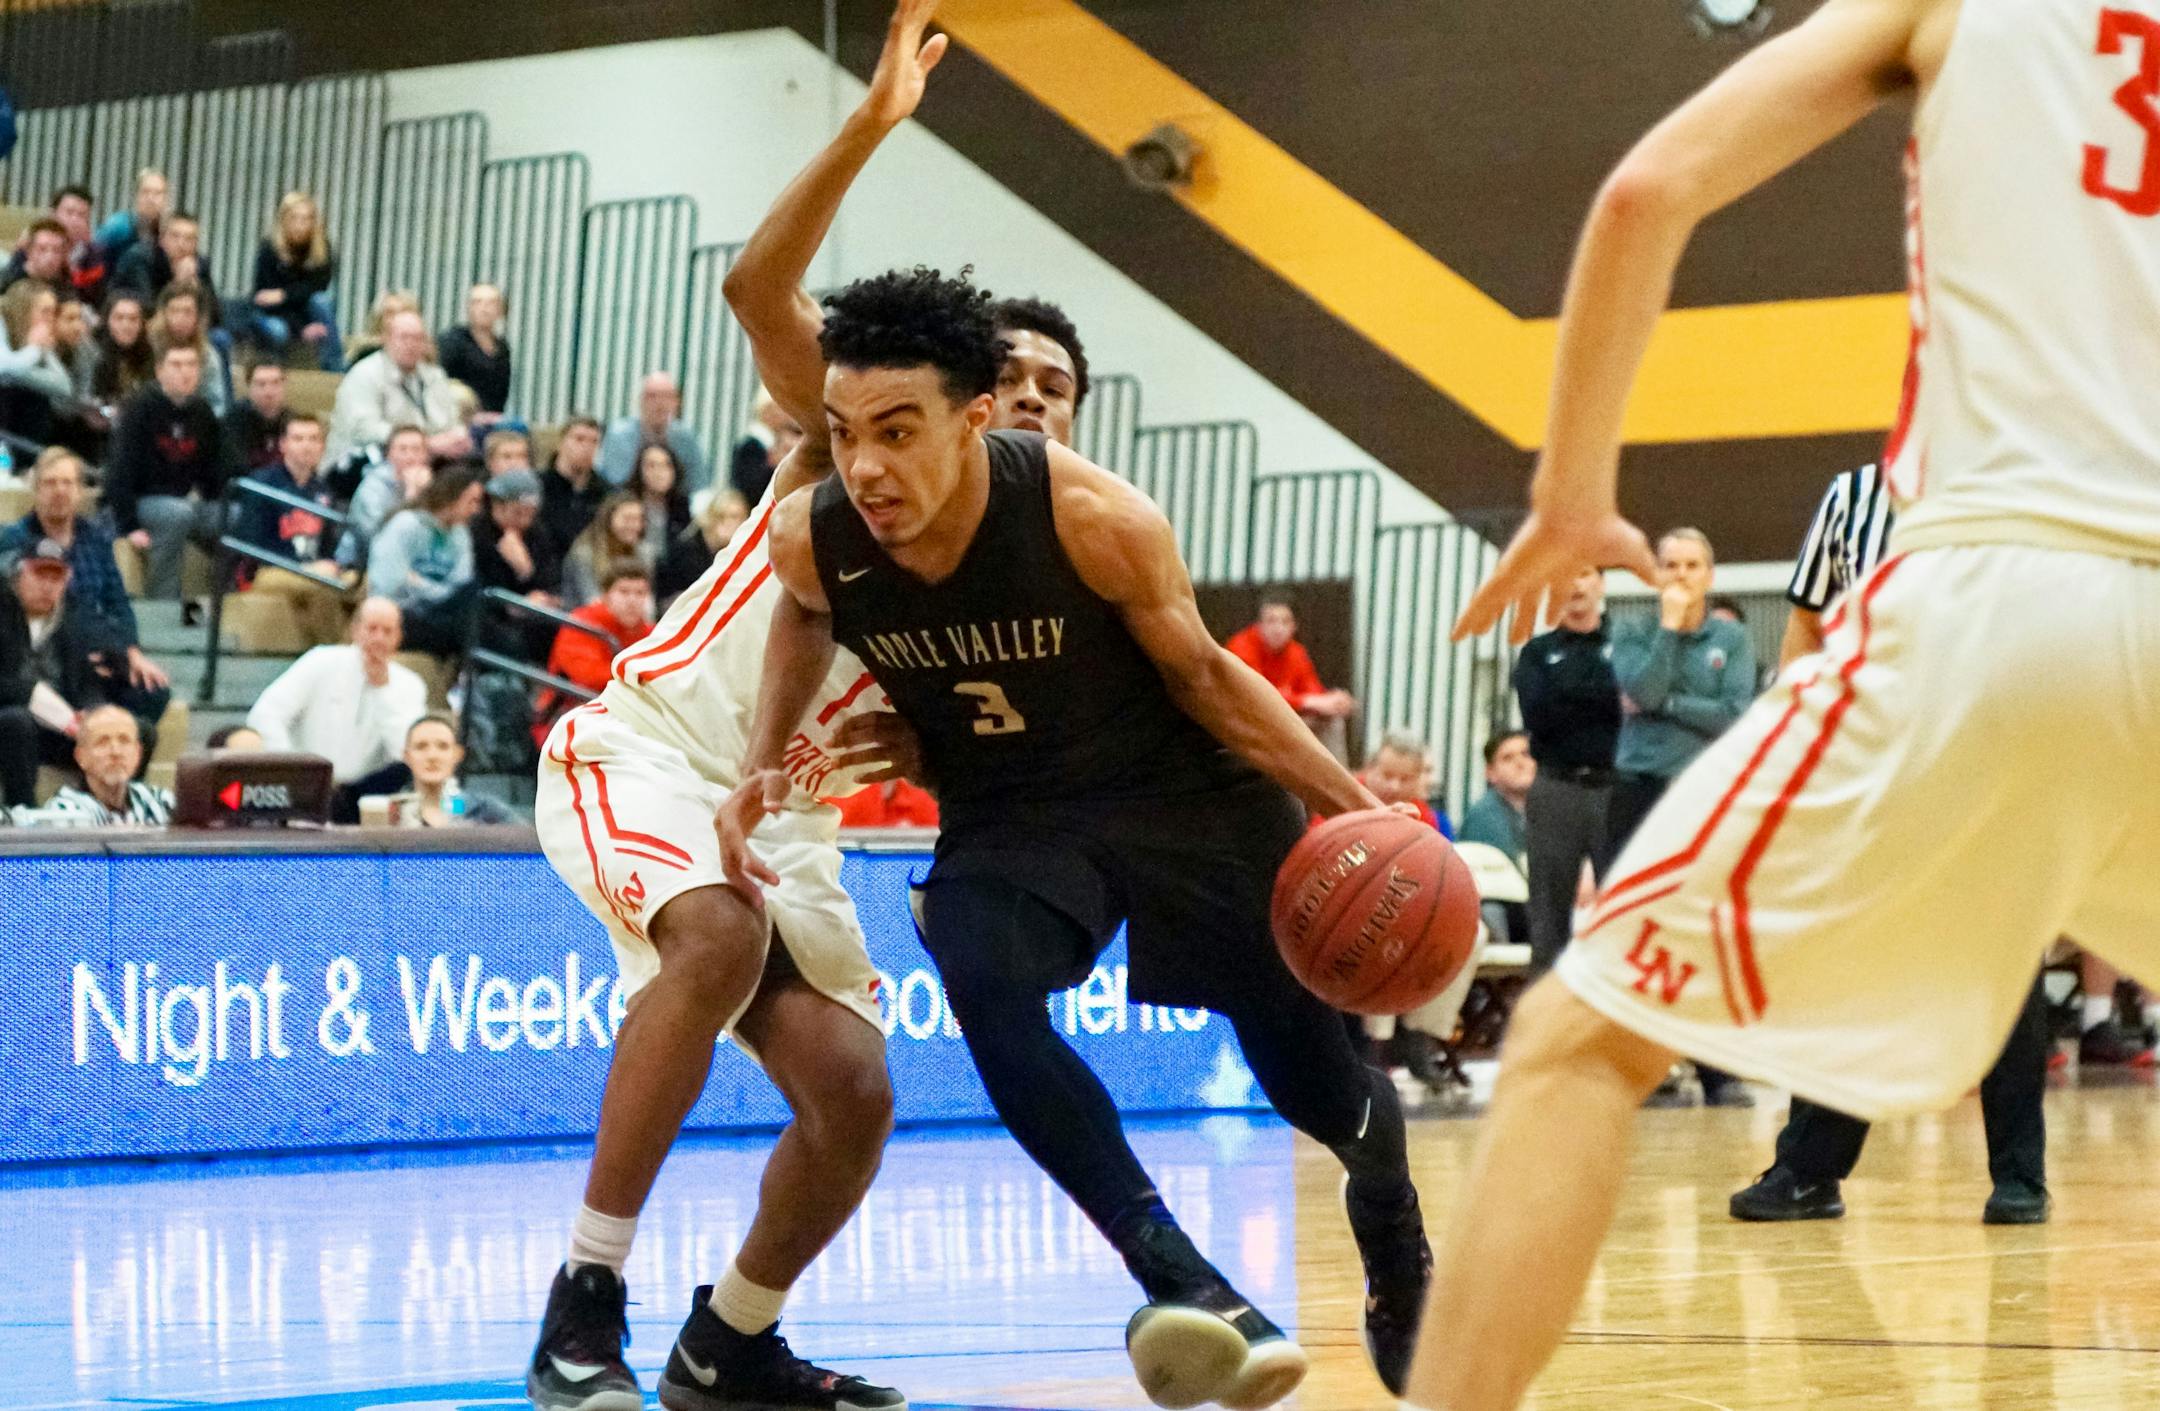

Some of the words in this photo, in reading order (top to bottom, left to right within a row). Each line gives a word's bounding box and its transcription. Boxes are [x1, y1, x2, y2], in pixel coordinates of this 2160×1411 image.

[862, 629, 948, 669] APPLE
[945, 617, 1065, 666] VALLEY
[953, 681, 1026, 736] 3
[1625, 919, 1697, 1005] LN
[73, 961, 291, 1087] Night
[318, 955, 374, 1057] &
